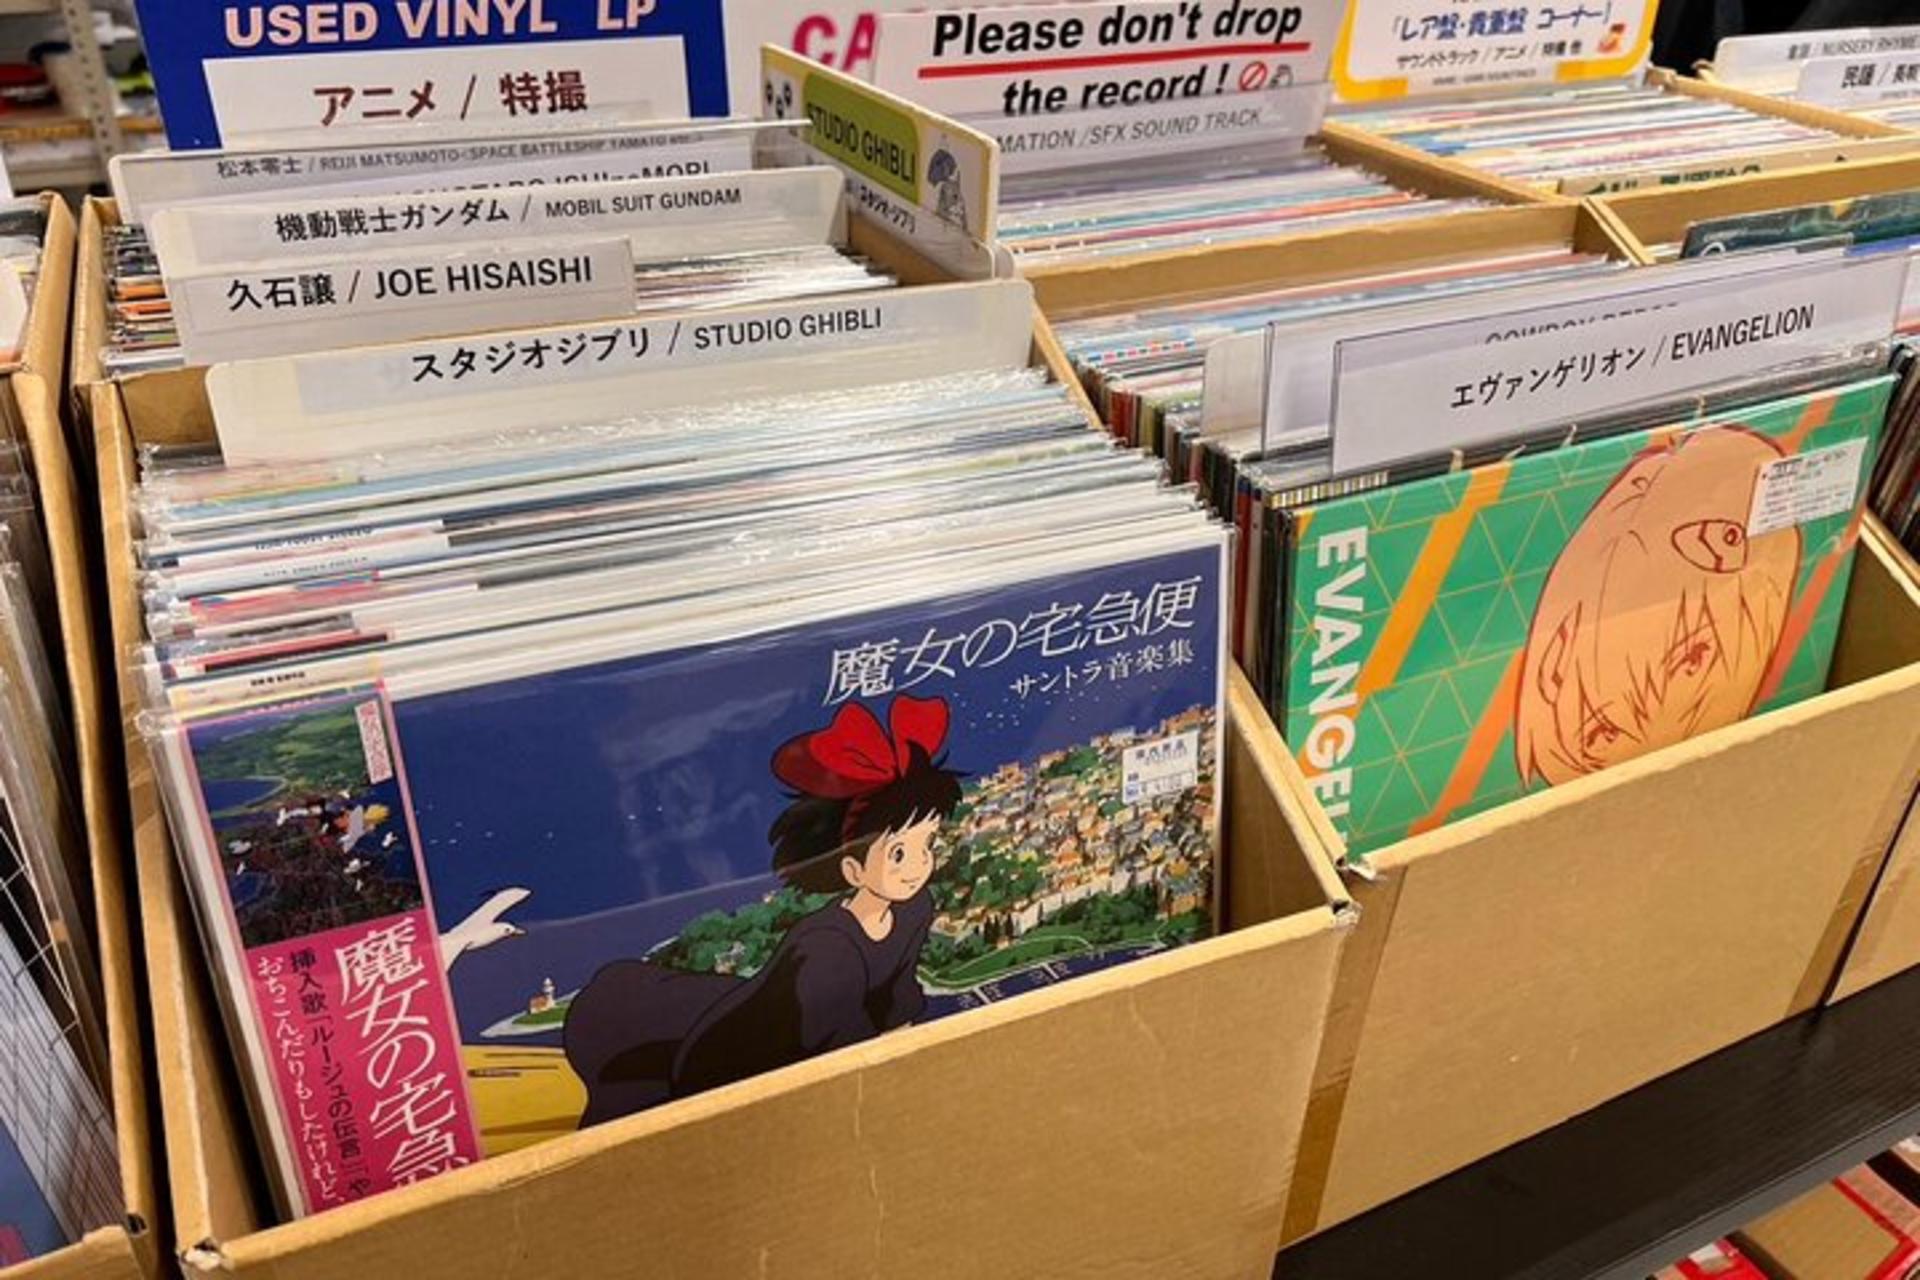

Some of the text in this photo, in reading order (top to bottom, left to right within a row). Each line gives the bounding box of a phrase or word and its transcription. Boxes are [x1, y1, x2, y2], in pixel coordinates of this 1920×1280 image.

[225, 0, 657, 47] USED VINYL LP
[933, 0, 1303, 57] Please don't drop
[314, 80, 436, 126] アニメ
[500, 70, 588, 115] 特撮
[1002, 79, 1068, 117] the
[1080, 65, 1207, 111] record
[806, 100, 917, 184] STUDIO GHIBLI
[1133, 116, 1199, 140] SOUND
[1203, 107, 1262, 131] TRACK
[275, 198, 510, 243] 機動戦士ガンダム
[545, 199, 608, 218] MOBIL
[612, 194, 655, 214] SUIT
[659, 188, 742, 210] GUNDAM
[227, 273, 337, 311] 久石譲
[374, 266, 437, 300] JOE
[447, 256, 593, 293] HISAISHI
[412, 327, 649, 383] スタジオジブリ
[694, 317, 793, 351] STUDIO
[799, 307, 882, 338] GHIBLI
[1450, 345, 1647, 409] エヴァンゲリオン
[1670, 303, 1816, 361] EVANGELION
[822, 575, 1203, 706] 魔女の宅急便
[1010, 638, 1195, 700] サントラ音楽集
[1308, 525, 1369, 843] EVANGE
